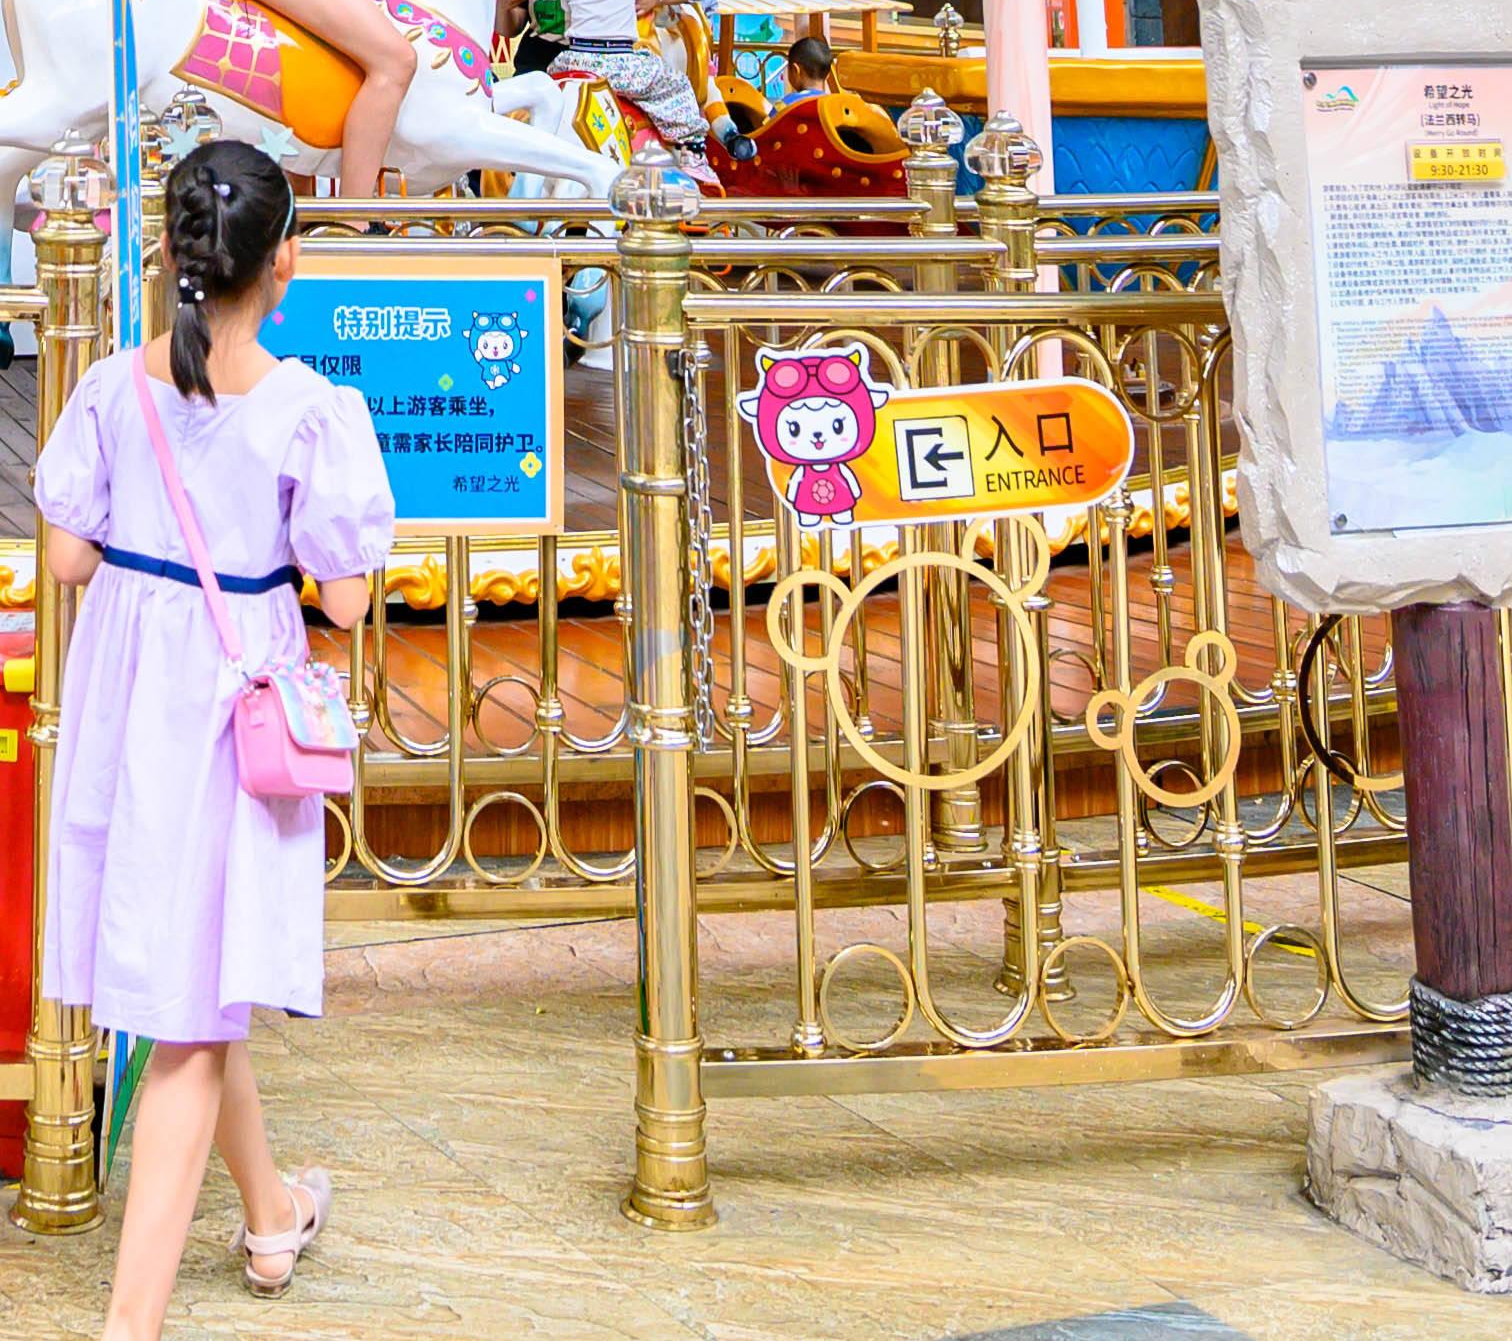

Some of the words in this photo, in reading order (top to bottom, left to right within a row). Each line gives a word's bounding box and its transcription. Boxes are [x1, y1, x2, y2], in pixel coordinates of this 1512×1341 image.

[1424, 85, 1474, 99] 希望之光
[1430, 164, 1489, 176] 9:30-21:30
[333, 305, 451, 341] 特别提示
[985, 412, 1075, 461] 入口
[452, 475, 520, 493] 希望之光
[986, 464, 1086, 493] ENTRANCE
